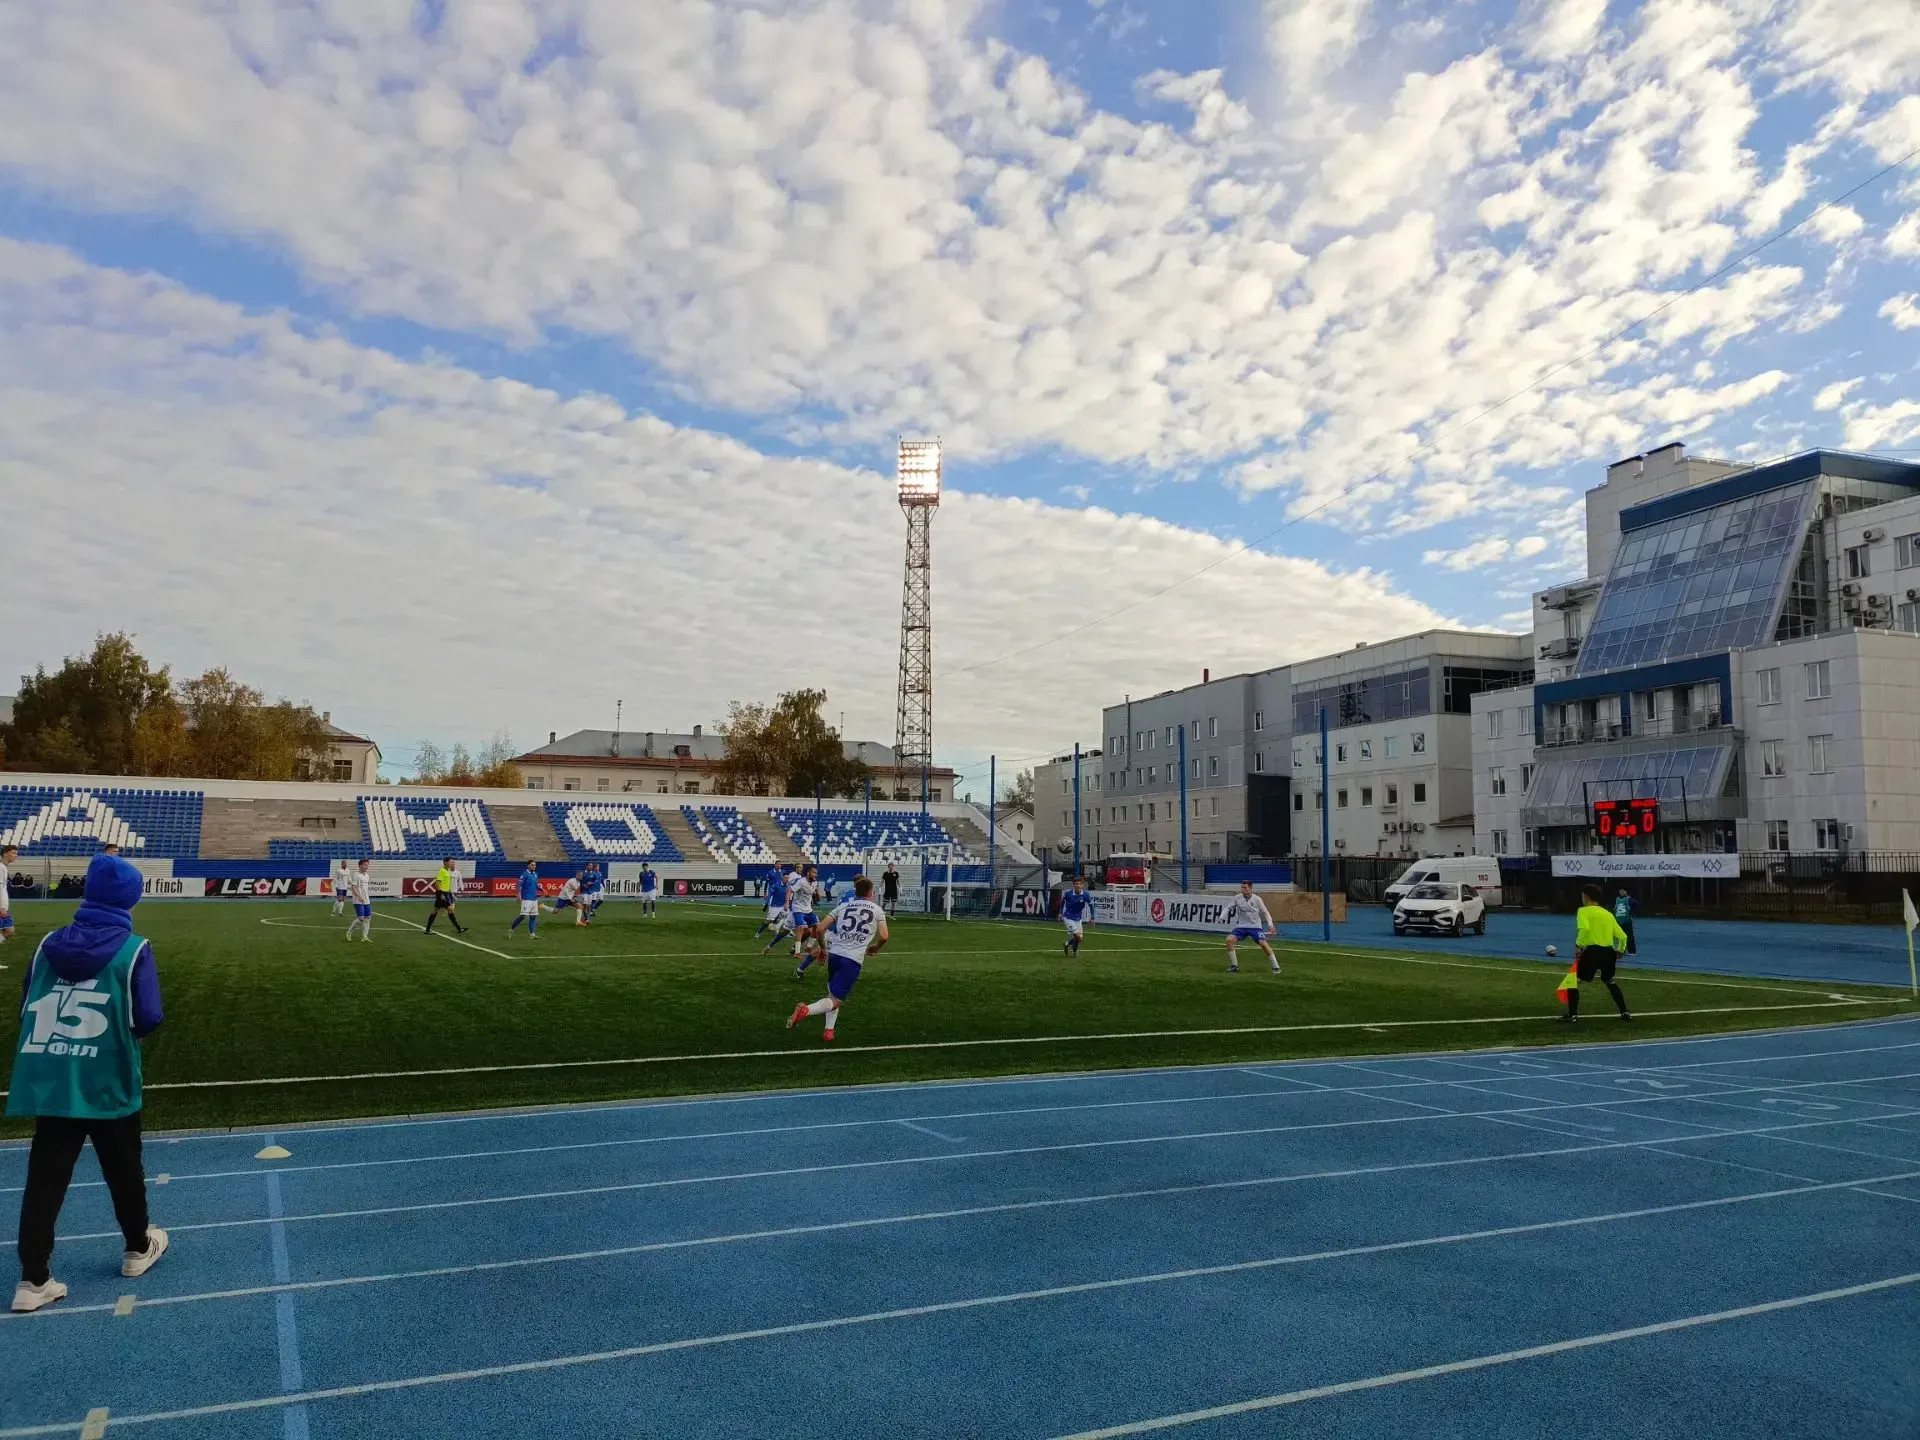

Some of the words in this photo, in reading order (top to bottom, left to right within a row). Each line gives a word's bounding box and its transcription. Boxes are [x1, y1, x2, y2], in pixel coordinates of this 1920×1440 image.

[1600, 814, 1611, 835] 0
[1643, 812, 1654, 833] 0
[1598, 859, 1623, 872] Через
[1625, 861, 1647, 873] годы
[1649, 863, 1655, 871] и
[1657, 859, 1681, 871] века
[155, 878, 184, 894] finch
[1478, 874, 1489, 882] 103
[220, 878, 292, 896] LEON
[495, 882, 517, 891] LOVE
[691, 883, 704, 892] VK
[705, 882, 735, 893] Видео
[841, 907, 874, 935] 52
[1169, 902, 1239, 925] МАРТЕН.Р
[27, 989, 112, 1044] 15
[47, 1042, 99, 1058] ФНЛ
